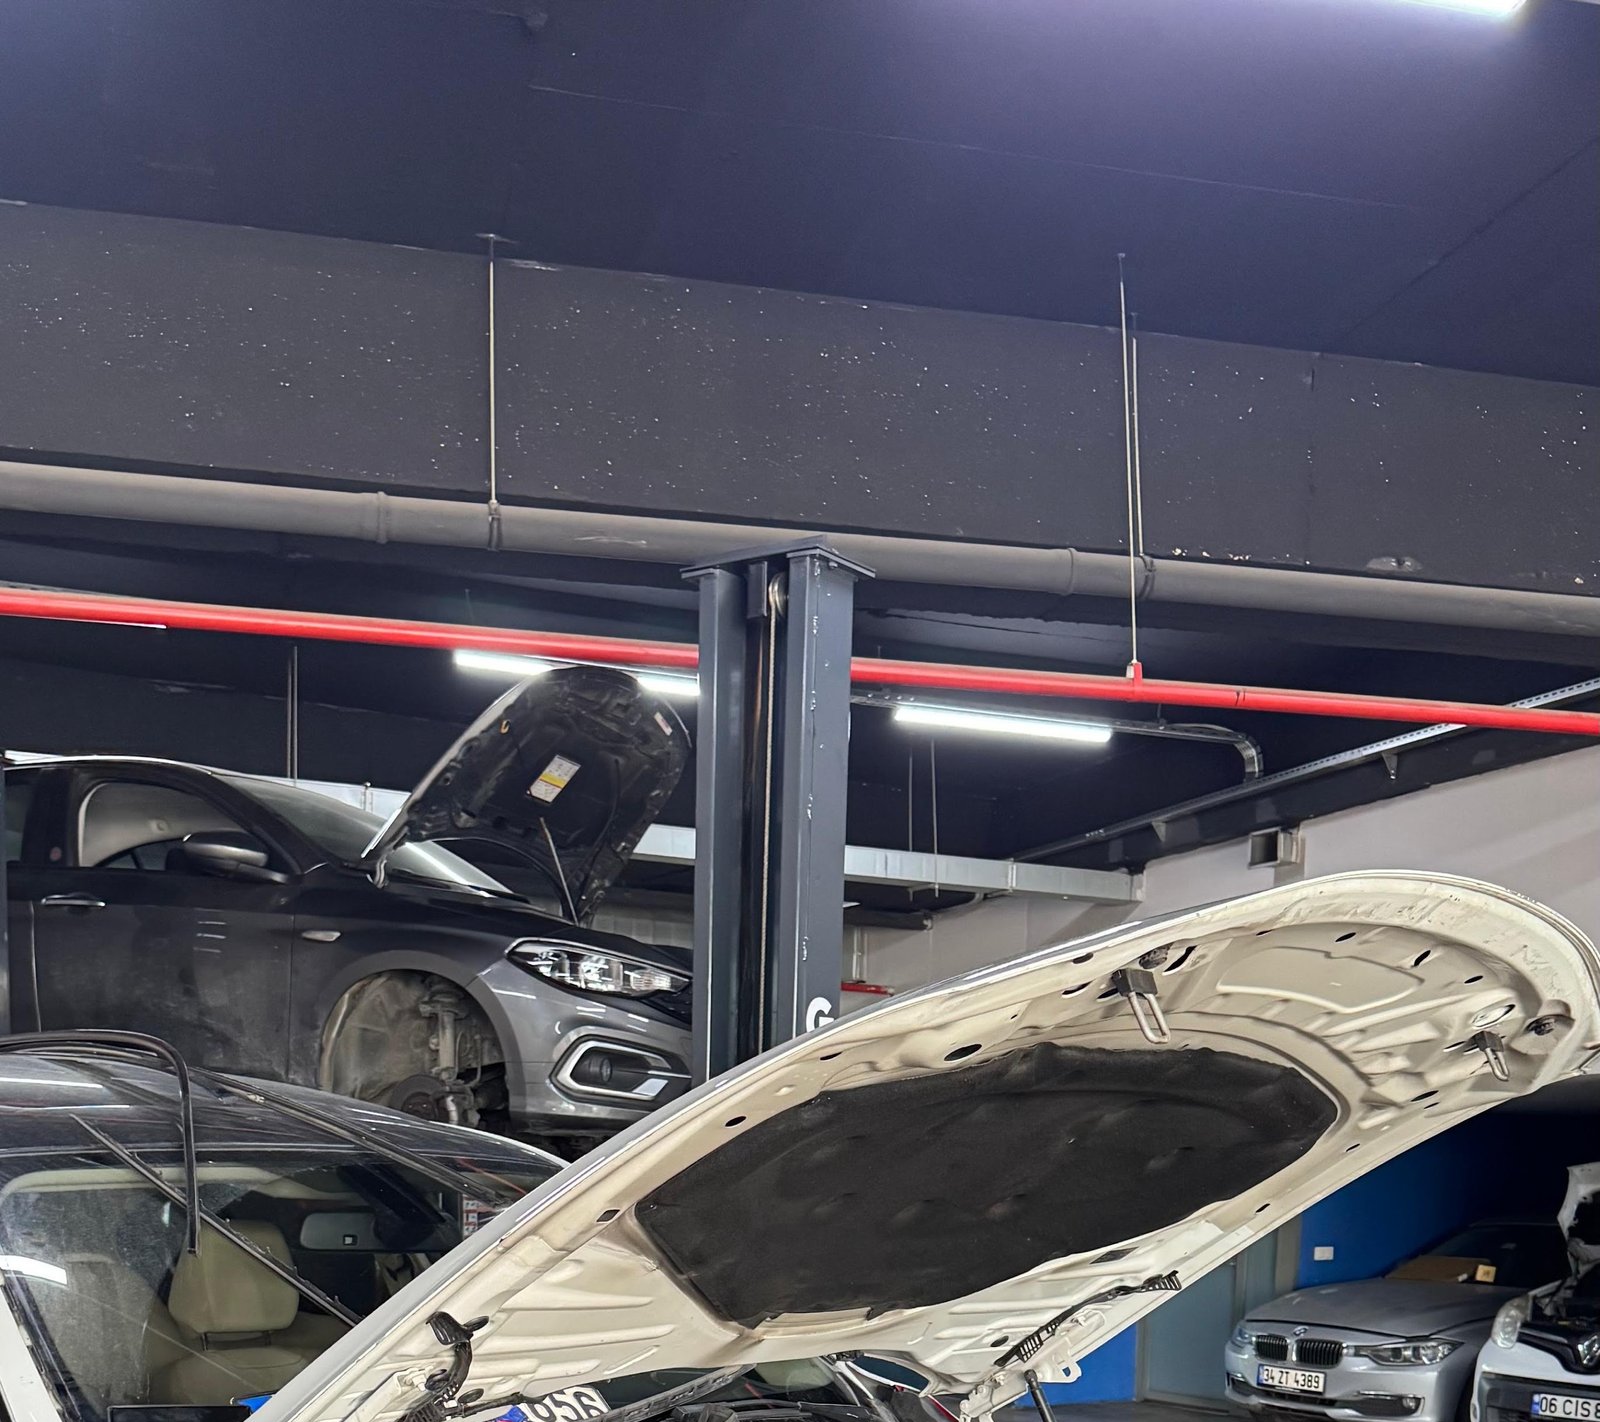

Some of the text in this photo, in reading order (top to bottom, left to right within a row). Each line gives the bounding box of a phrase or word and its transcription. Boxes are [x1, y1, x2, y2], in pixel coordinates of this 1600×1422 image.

[806, 996, 834, 1033] G
[1264, 1368, 1320, 1389] 34 ZT 4389
[1540, 1396, 1557, 1414] 06
[1563, 1399, 1591, 1418] CIS
